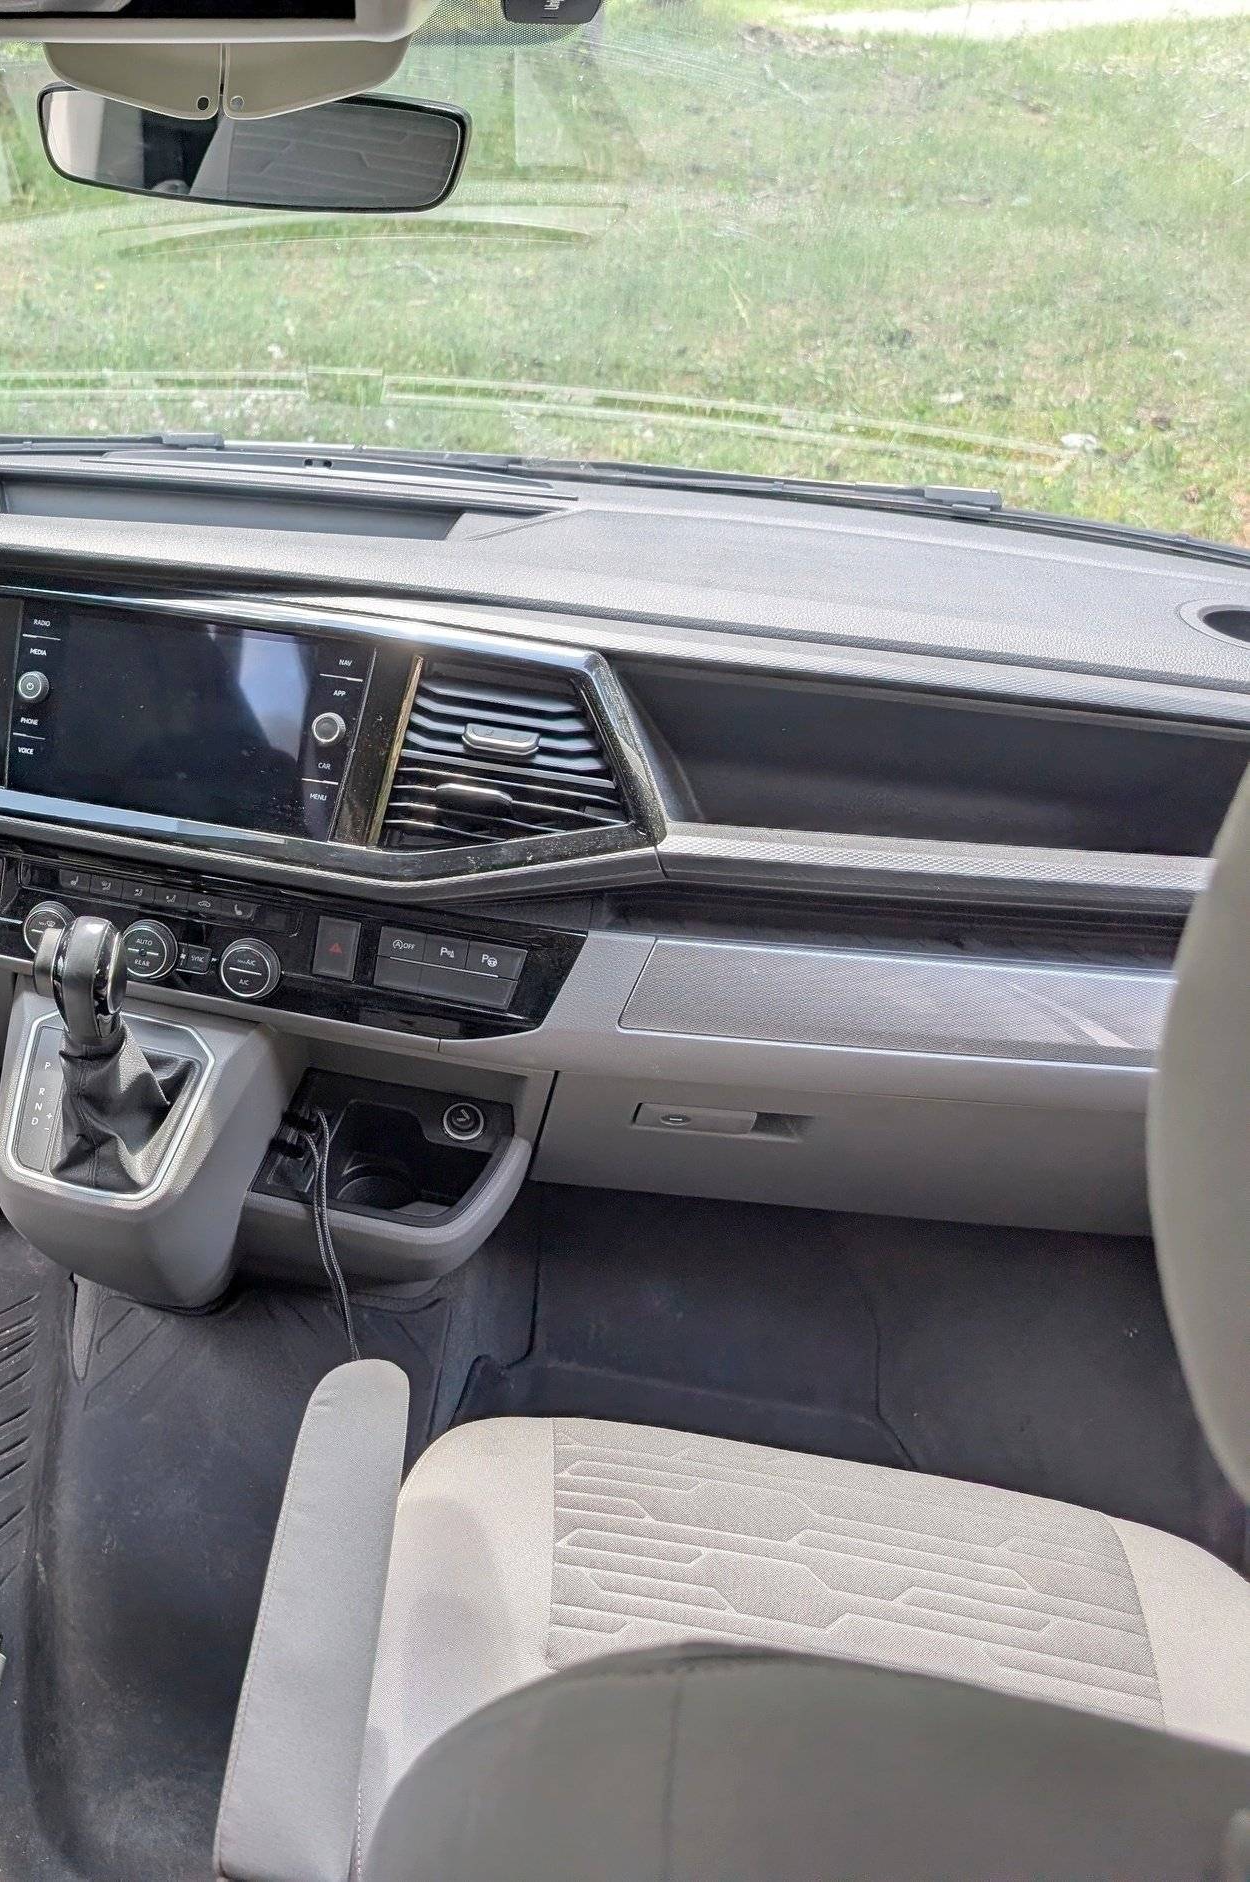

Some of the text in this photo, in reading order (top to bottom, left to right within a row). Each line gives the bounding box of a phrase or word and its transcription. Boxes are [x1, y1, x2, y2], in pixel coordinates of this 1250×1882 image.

[33, 618, 50, 627] RADIO
[29, 647, 47, 656] MEDIA
[338, 659, 352, 667] NAV
[20, 717, 39, 726] PHONE
[17, 747, 35, 755] VOICE
[309, 793, 327, 801] MENU
[136, 938, 153, 946] AUTO
[403, 942, 416, 951] OFF
[134, 958, 150, 967] REAR
[191, 955, 205, 963] SYNC
[238, 978, 249, 986] A/C
[44, 1061, 51, 1071] P
[38, 1087, 46, 1096] R
[34, 1102, 43, 1111] N
[31, 1117, 39, 1126] D
